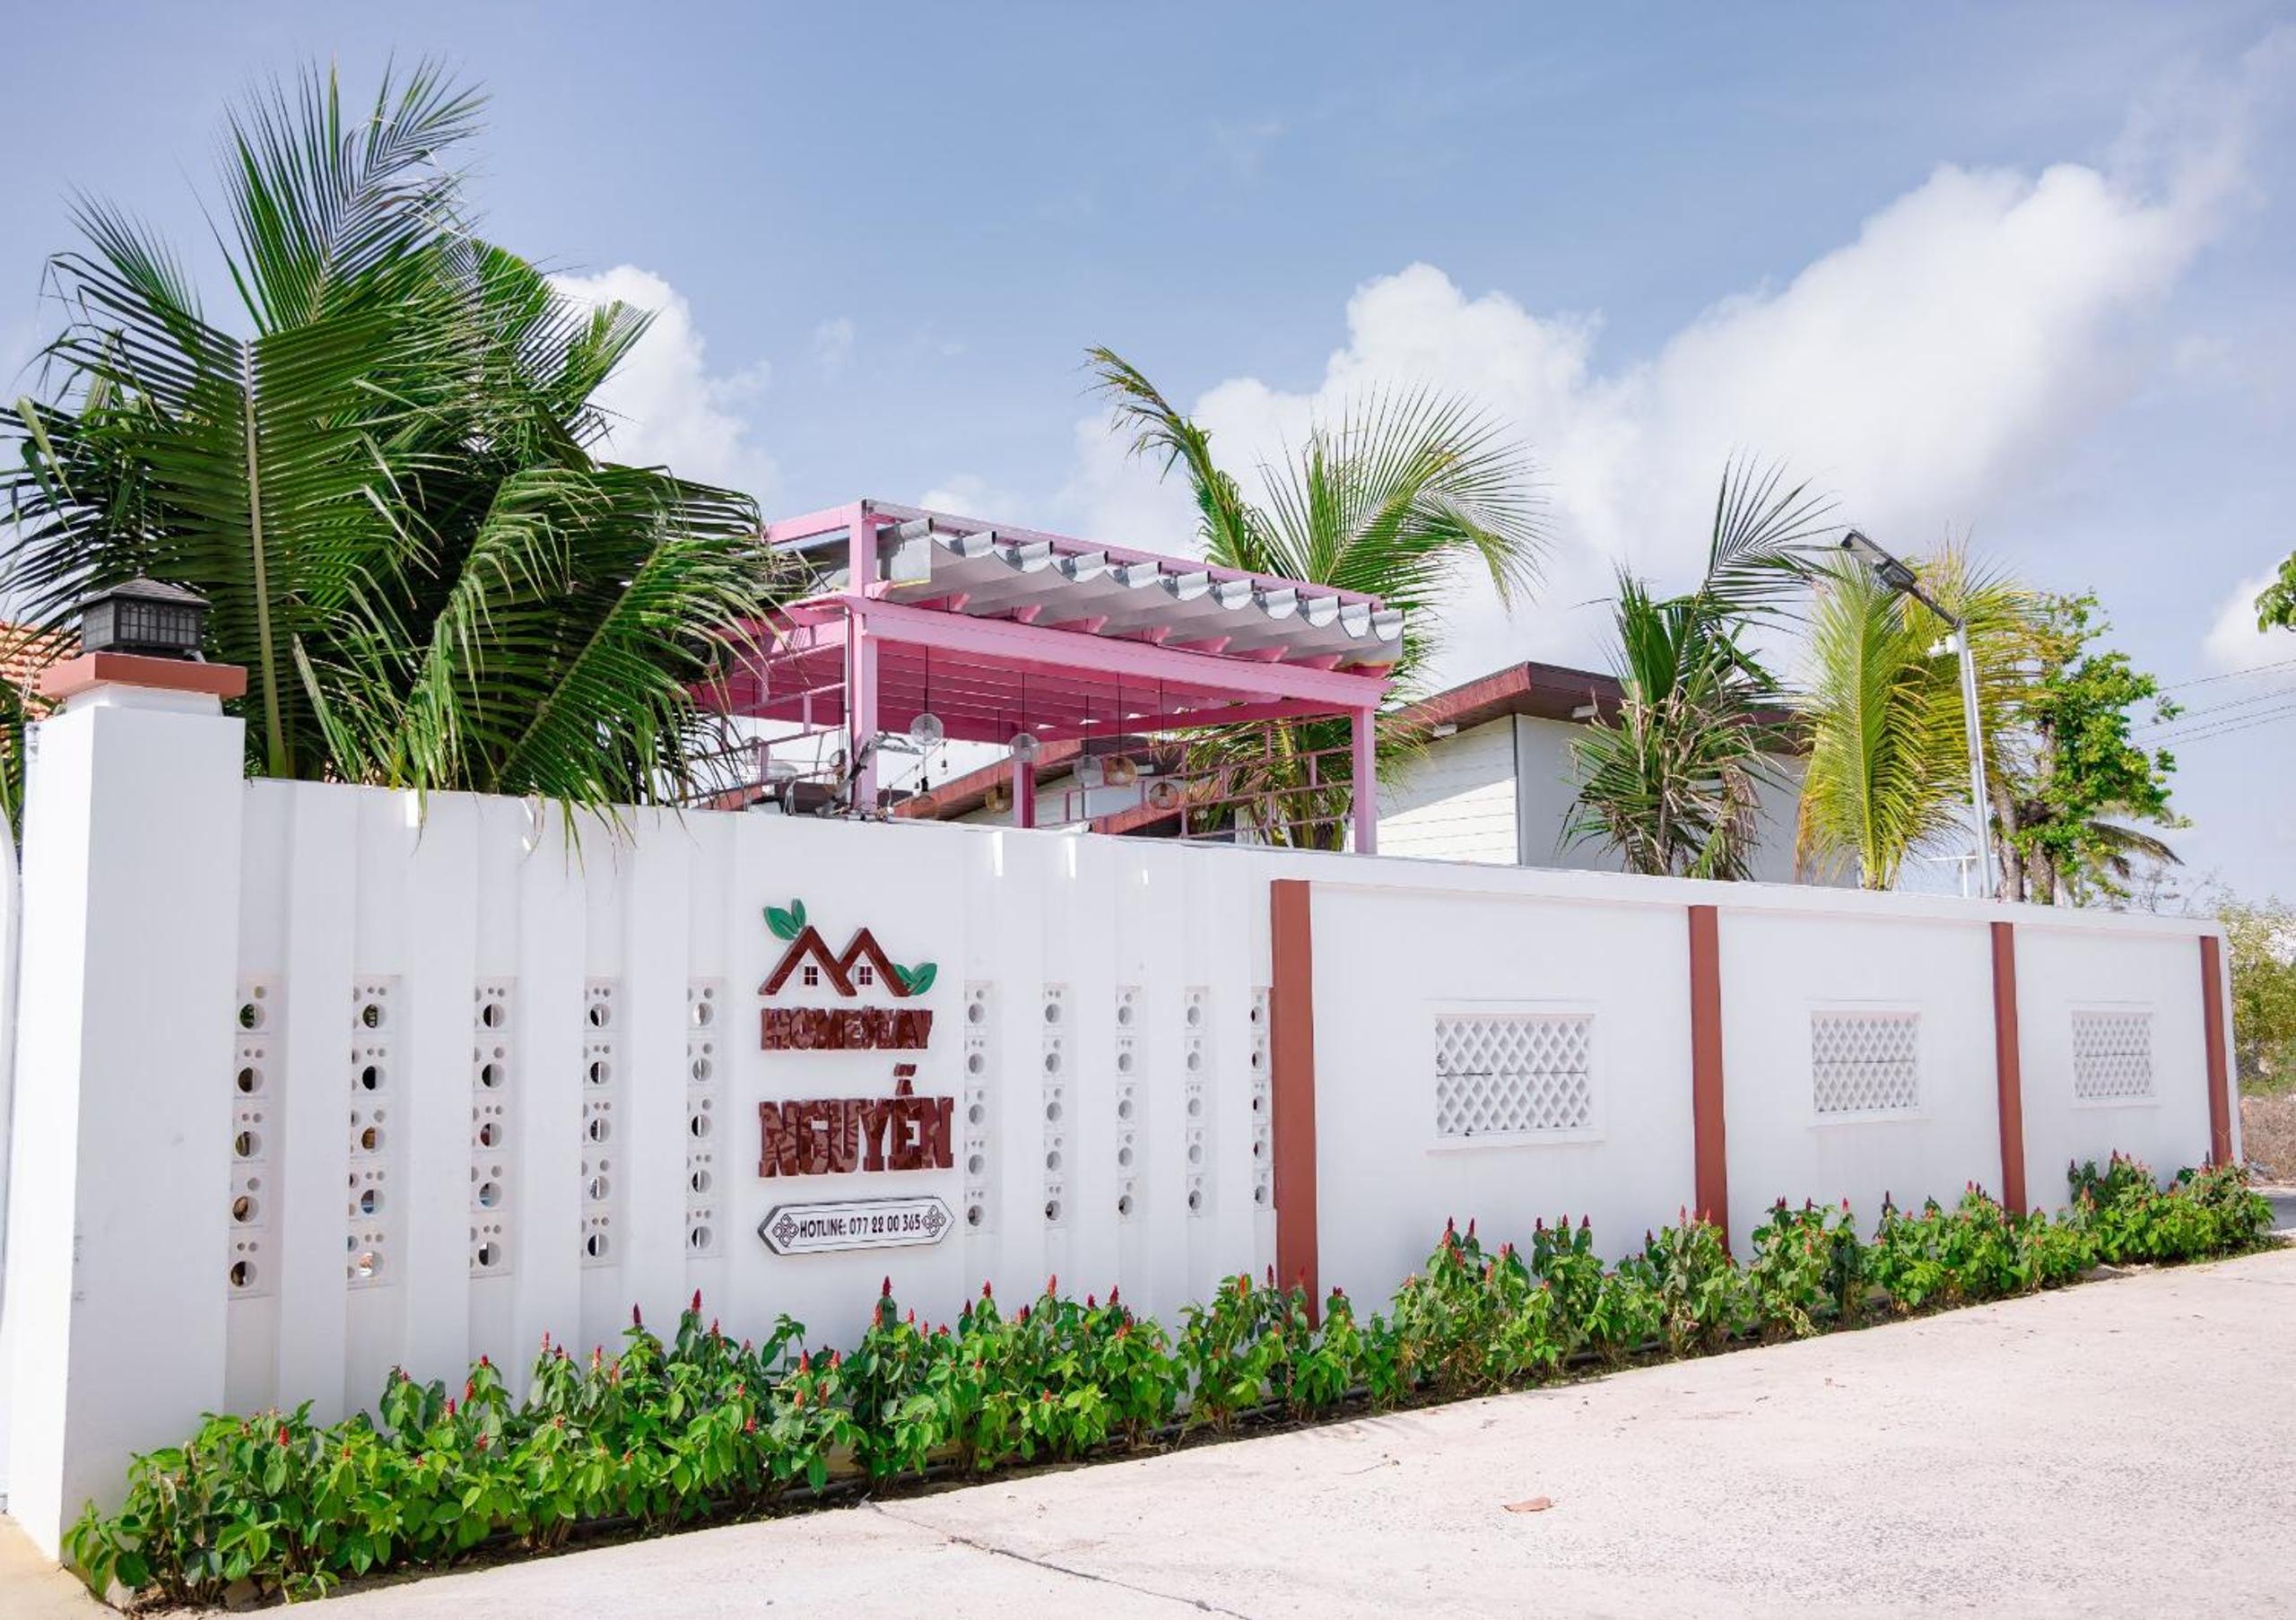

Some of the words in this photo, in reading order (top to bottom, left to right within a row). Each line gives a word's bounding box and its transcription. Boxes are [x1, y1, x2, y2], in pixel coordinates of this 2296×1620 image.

[800, 1218, 847, 1238] HOTLINE:
[849, 1216, 868, 1235] 077
[872, 1215, 883, 1233] 22
[887, 1215, 899, 1232] 00
[902, 1214, 921, 1231] 365
